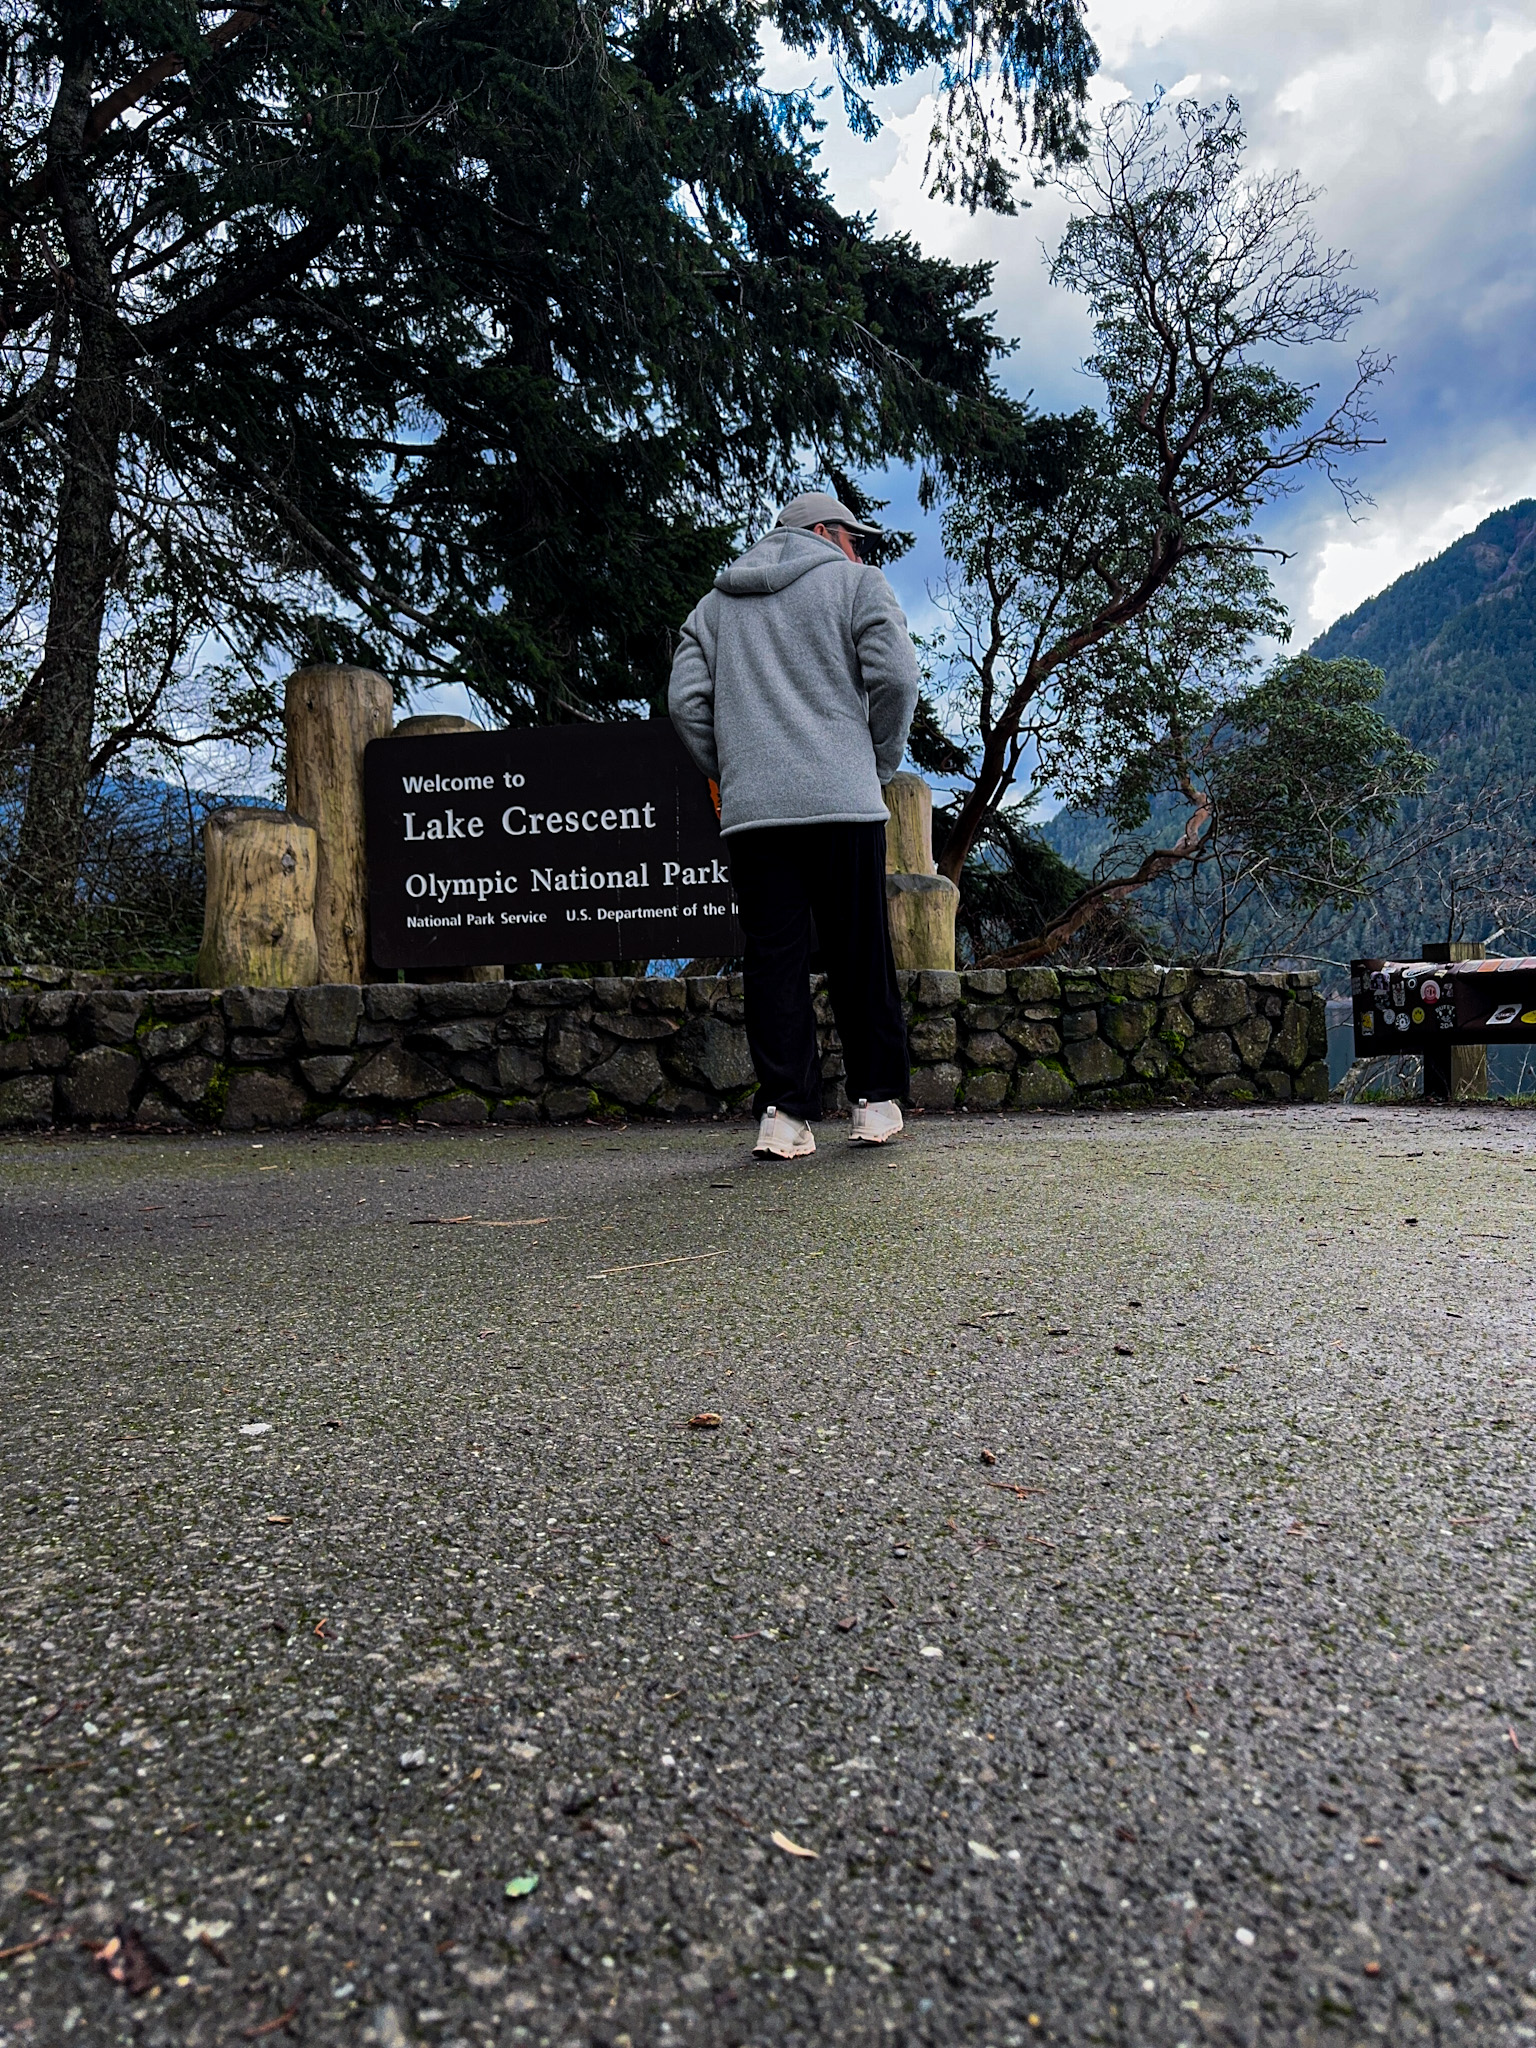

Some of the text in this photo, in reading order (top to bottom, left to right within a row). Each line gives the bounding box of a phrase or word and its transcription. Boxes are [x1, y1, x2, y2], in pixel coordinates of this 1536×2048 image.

[402, 771, 526, 794] Welcome to
[402, 801, 657, 841] Lake Crescent
[405, 858, 729, 904] Olympic National Park
[406, 916, 462, 929] National
[466, 913, 496, 926] Park
[500, 913, 548, 925] Service
[566, 909, 593, 922] U.S.
[597, 906, 679, 921] Department
[682, 902, 698, 917] of
[702, 902, 726, 916] the
